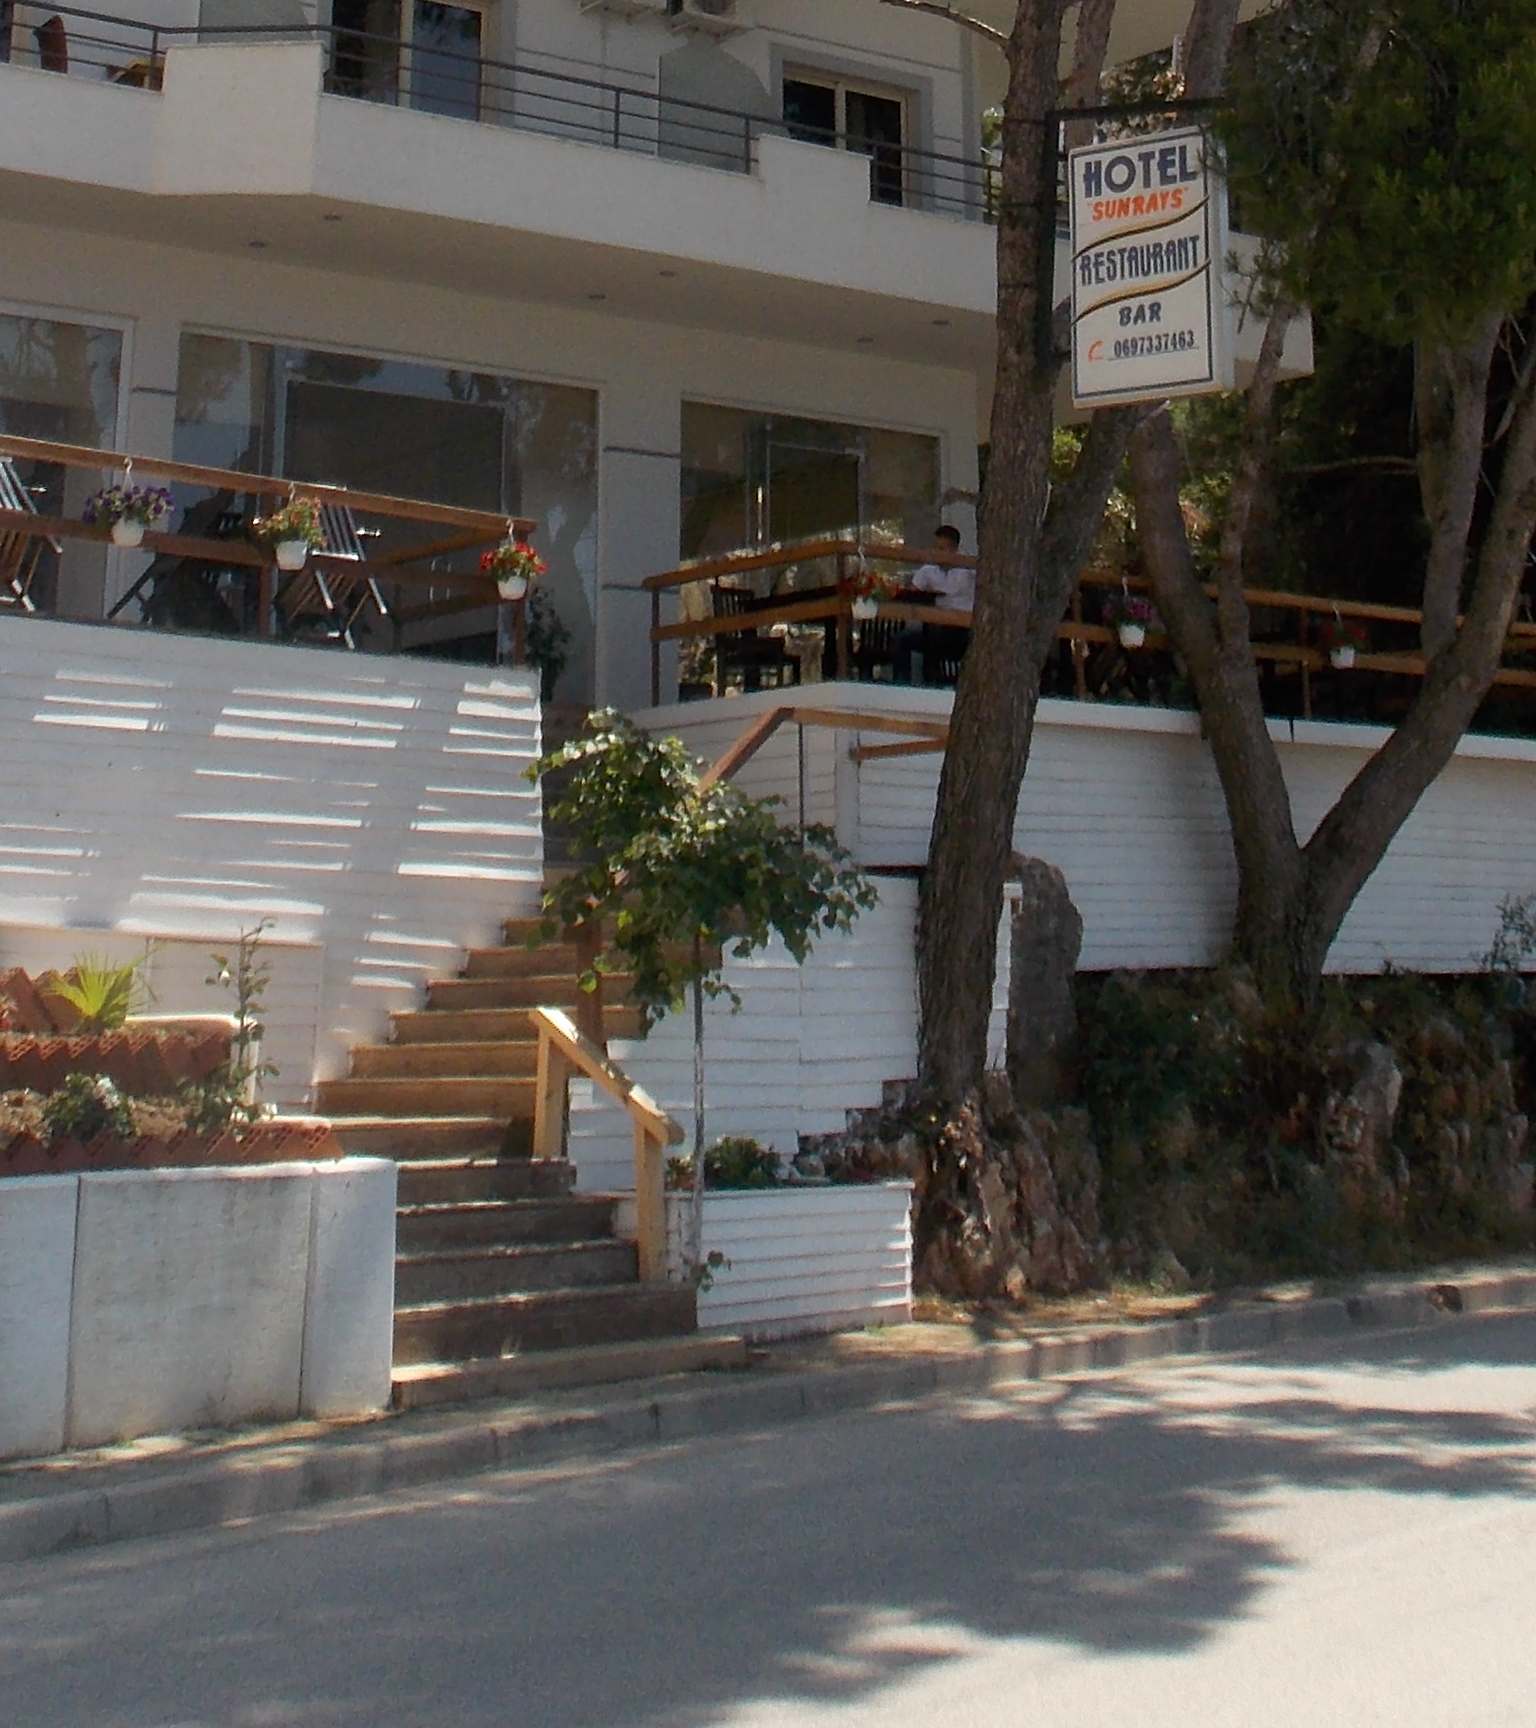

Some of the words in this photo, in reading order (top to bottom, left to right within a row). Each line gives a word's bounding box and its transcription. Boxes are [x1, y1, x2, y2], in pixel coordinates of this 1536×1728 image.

[1083, 145, 1197, 198] HOTEL
[1080, 236, 1200, 286] RESTAURANT
[1118, 302, 1162, 326] BAR
[1113, 331, 1195, 357] 0697337463
